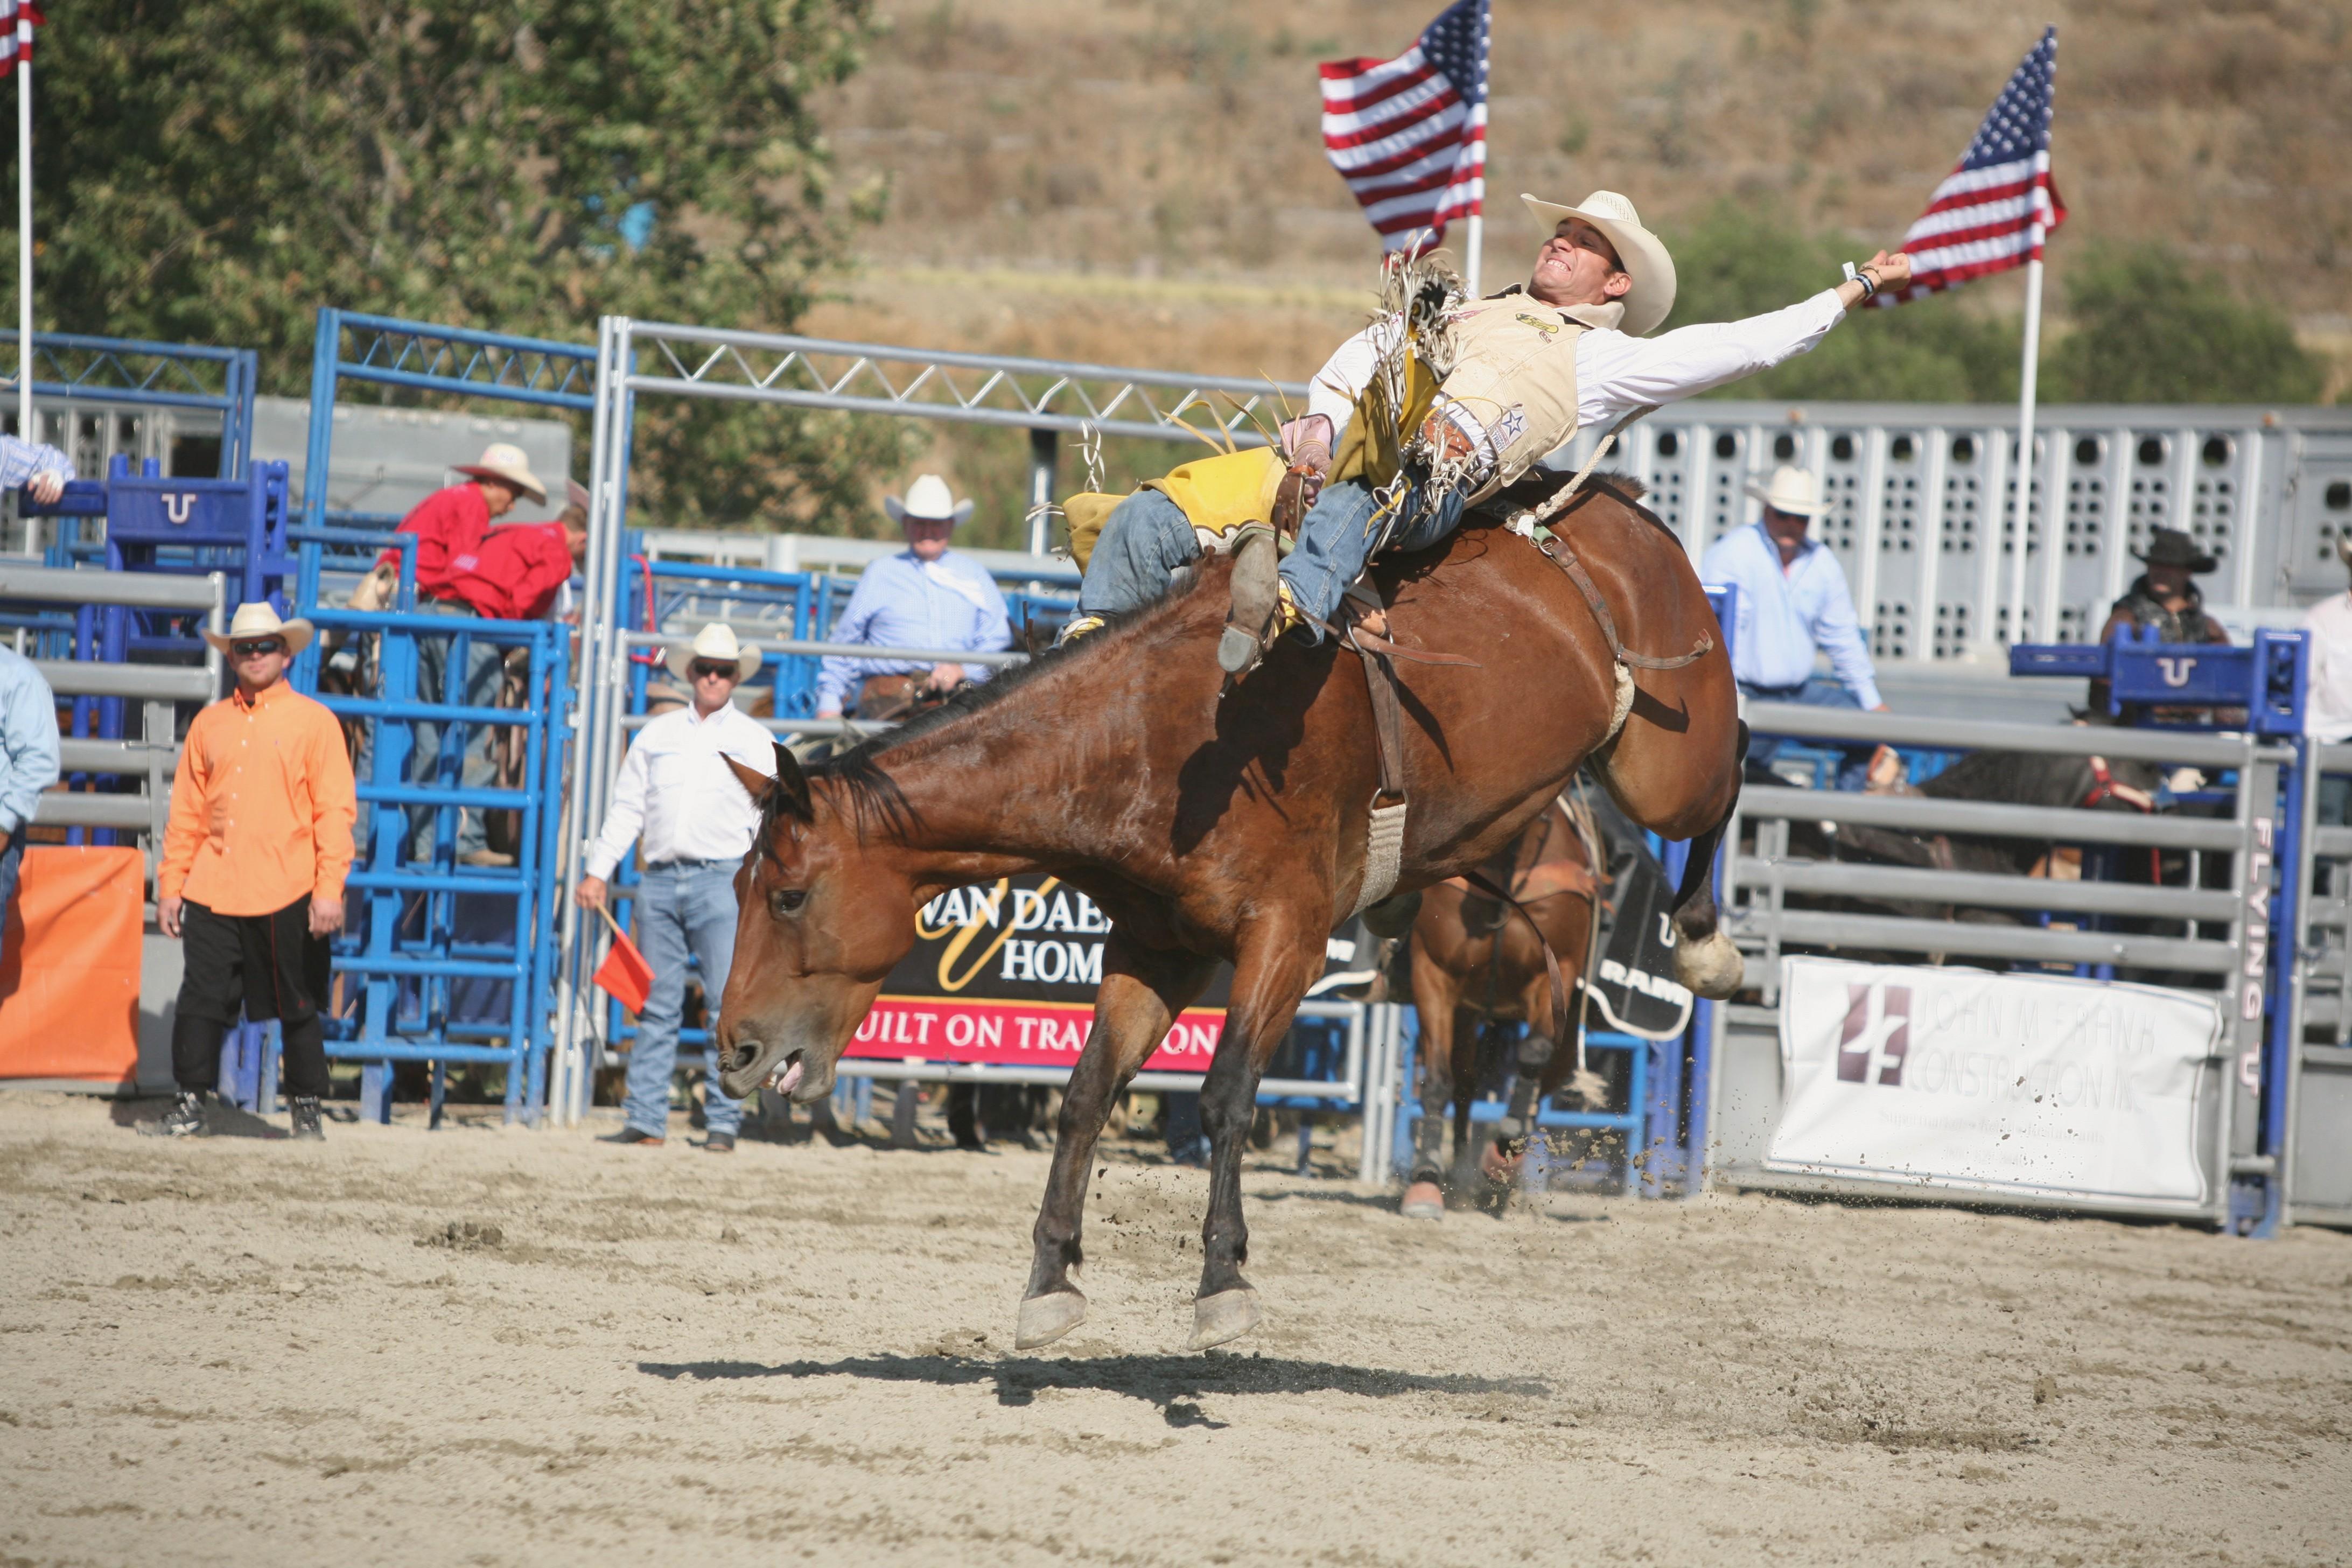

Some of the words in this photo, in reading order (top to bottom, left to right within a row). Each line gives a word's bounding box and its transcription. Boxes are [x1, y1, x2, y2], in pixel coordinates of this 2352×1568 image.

[922, 886, 1000, 929] VAN
[1012, 889, 1114, 934] DAE
[2243, 817, 2273, 1021] FLYING
[1000, 939, 1105, 985] HOM
[855, 1010, 938, 1045] UILT
[946, 1014, 1004, 1047] ON
[1915, 989, 2005, 1037] JOHN
[2017, 998, 2041, 1040] M
[1910, 1046, 2105, 1109] CONSTRUCTION
